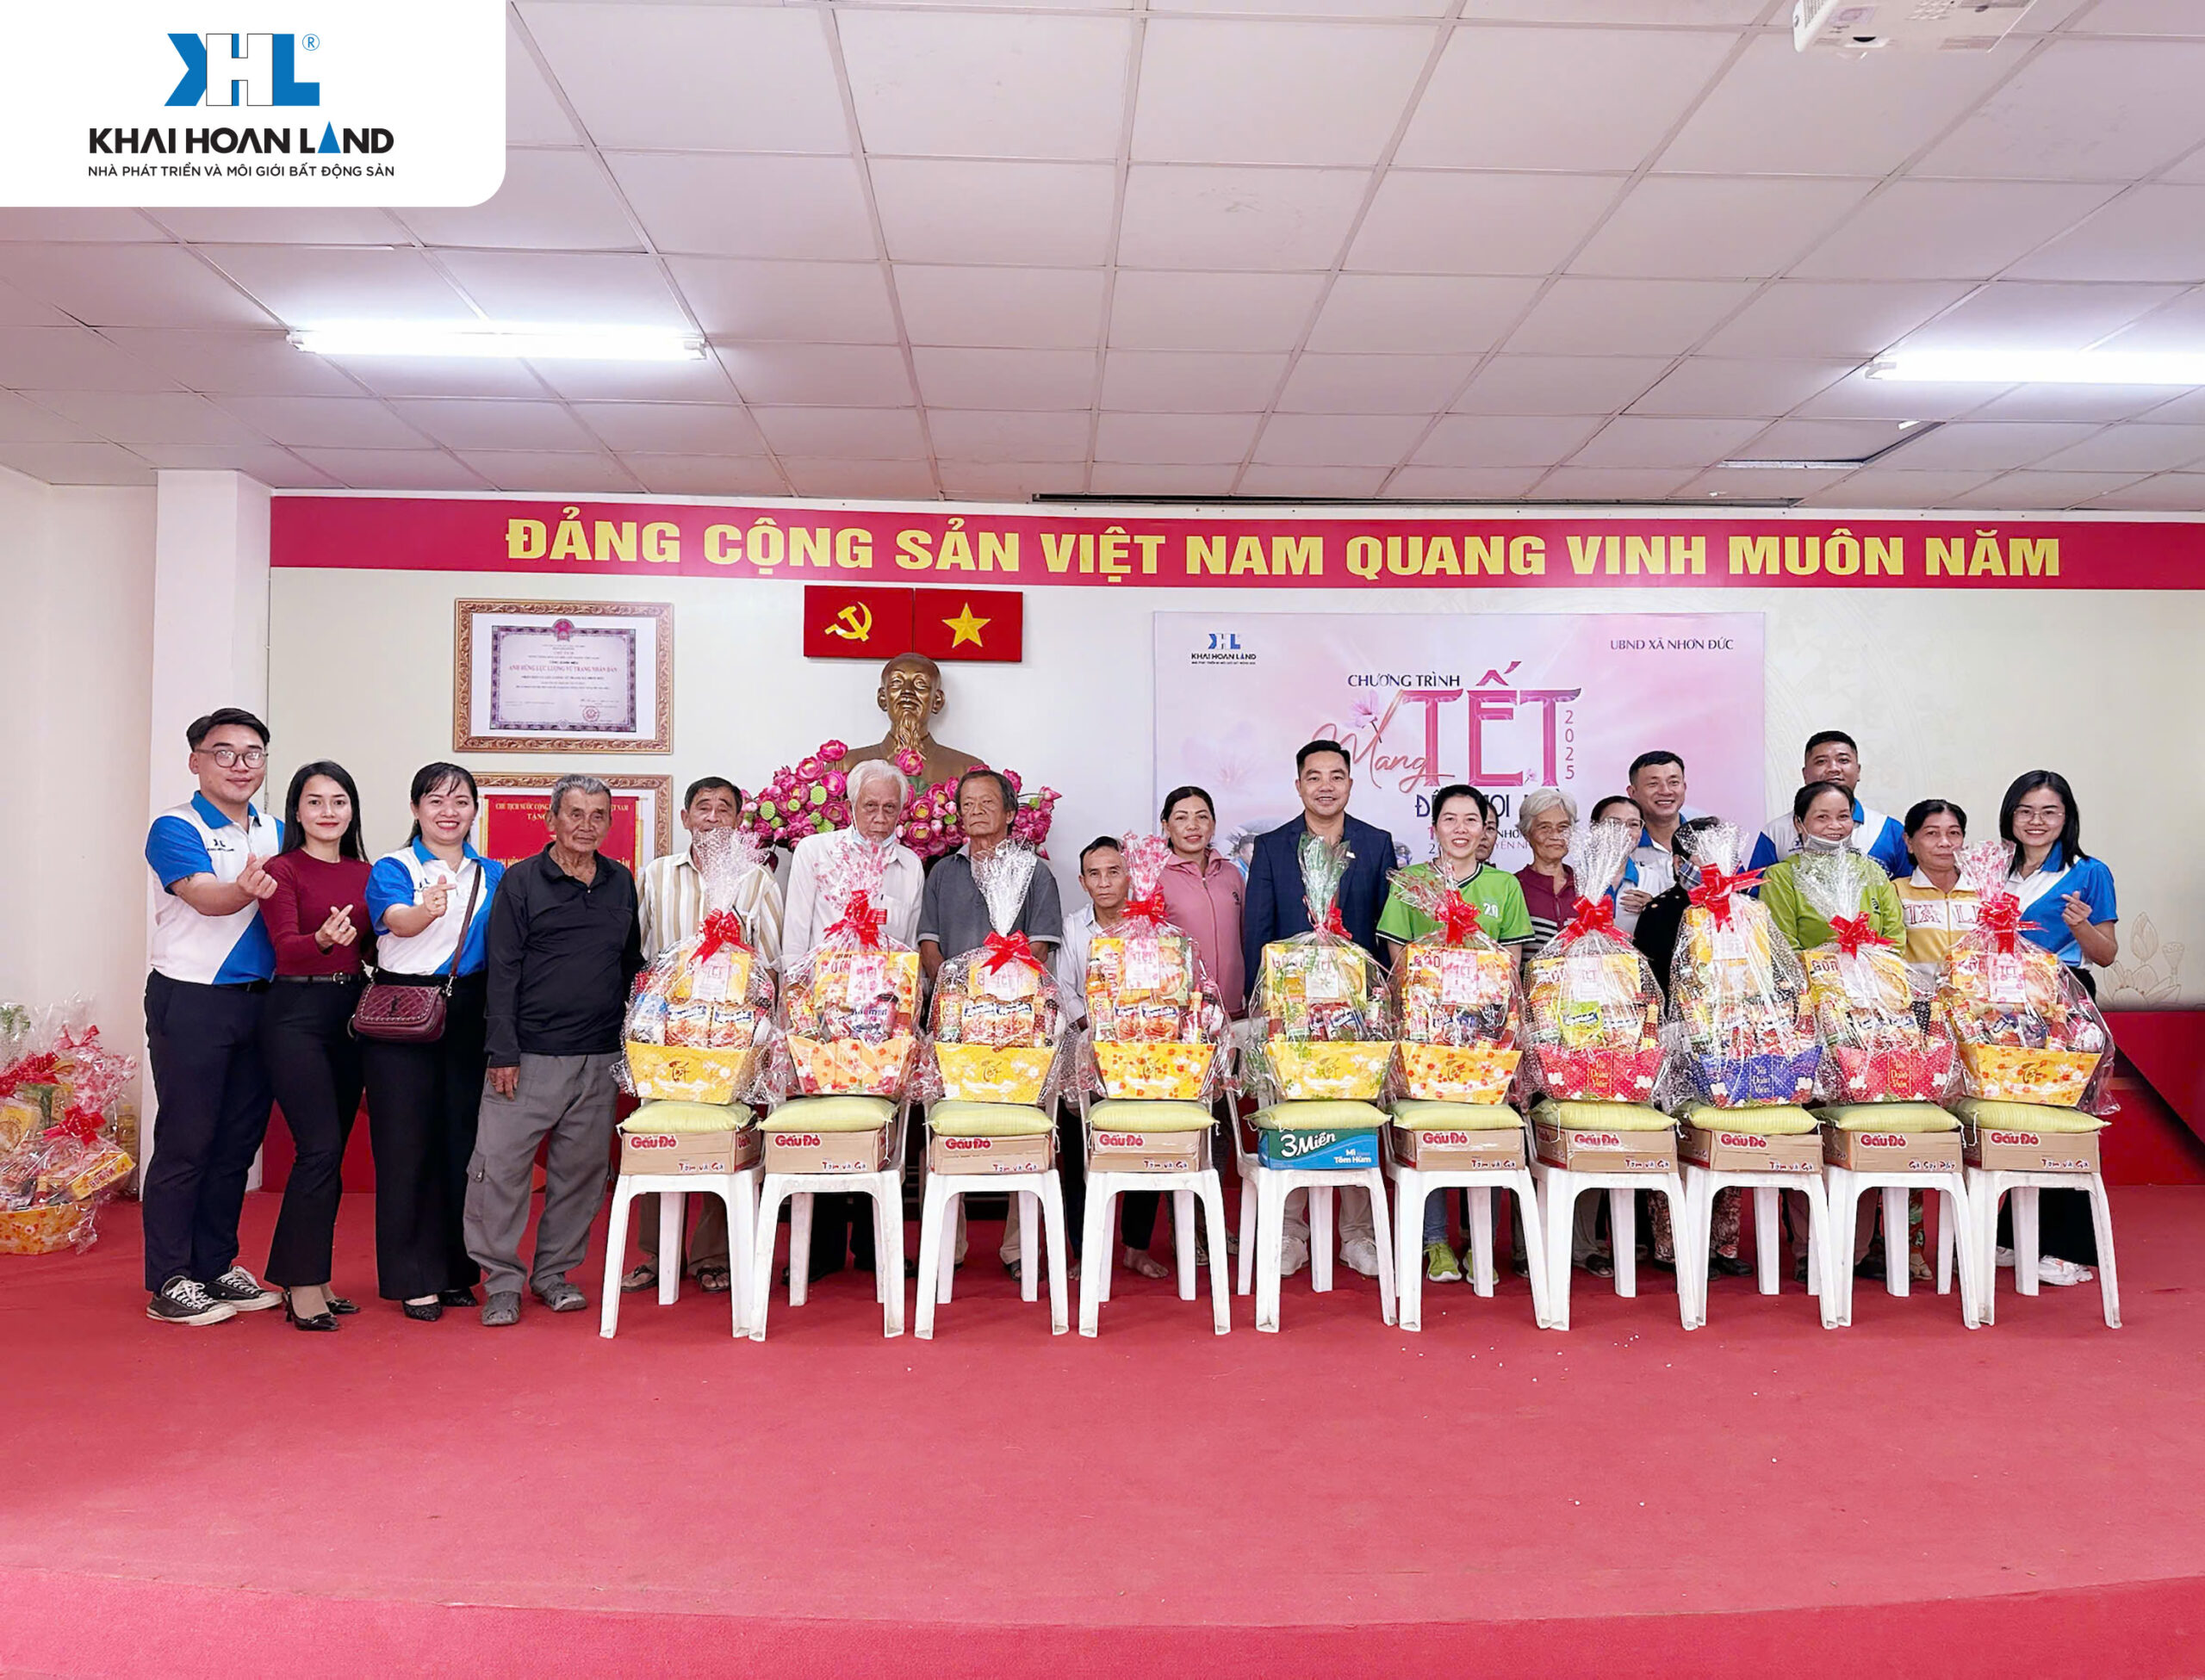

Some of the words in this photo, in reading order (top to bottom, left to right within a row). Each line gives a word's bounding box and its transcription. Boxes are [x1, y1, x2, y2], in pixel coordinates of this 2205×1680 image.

[506, 506, 680, 562] ĐẢNG
[705, 517, 873, 574] CỘNG
[896, 518, 1020, 572] SẢN
[1040, 526, 1165, 582] VIỆT
[1187, 536, 1324, 575] NAM
[1346, 536, 1546, 580] QUANG
[1568, 536, 1706, 575] VINH
[1729, 528, 1904, 575] MUÔN
[1926, 530, 2059, 576] NĂM
[1610, 640, 1645, 650] UBND
[1649, 637, 1665, 650] XÃ
[1668, 638, 1705, 650] NHƠN
[1708, 636, 1734, 650] ĐỨC
[1347, 673, 1412, 687] CHƯƠNG
[1415, 670, 1461, 687] TRÌNH
[1401, 660, 1582, 787] TẾT
[1563, 710, 1576, 780] 2025
[1483, 902, 1499, 918] 20
[1280, 1134, 1298, 1157] 3
